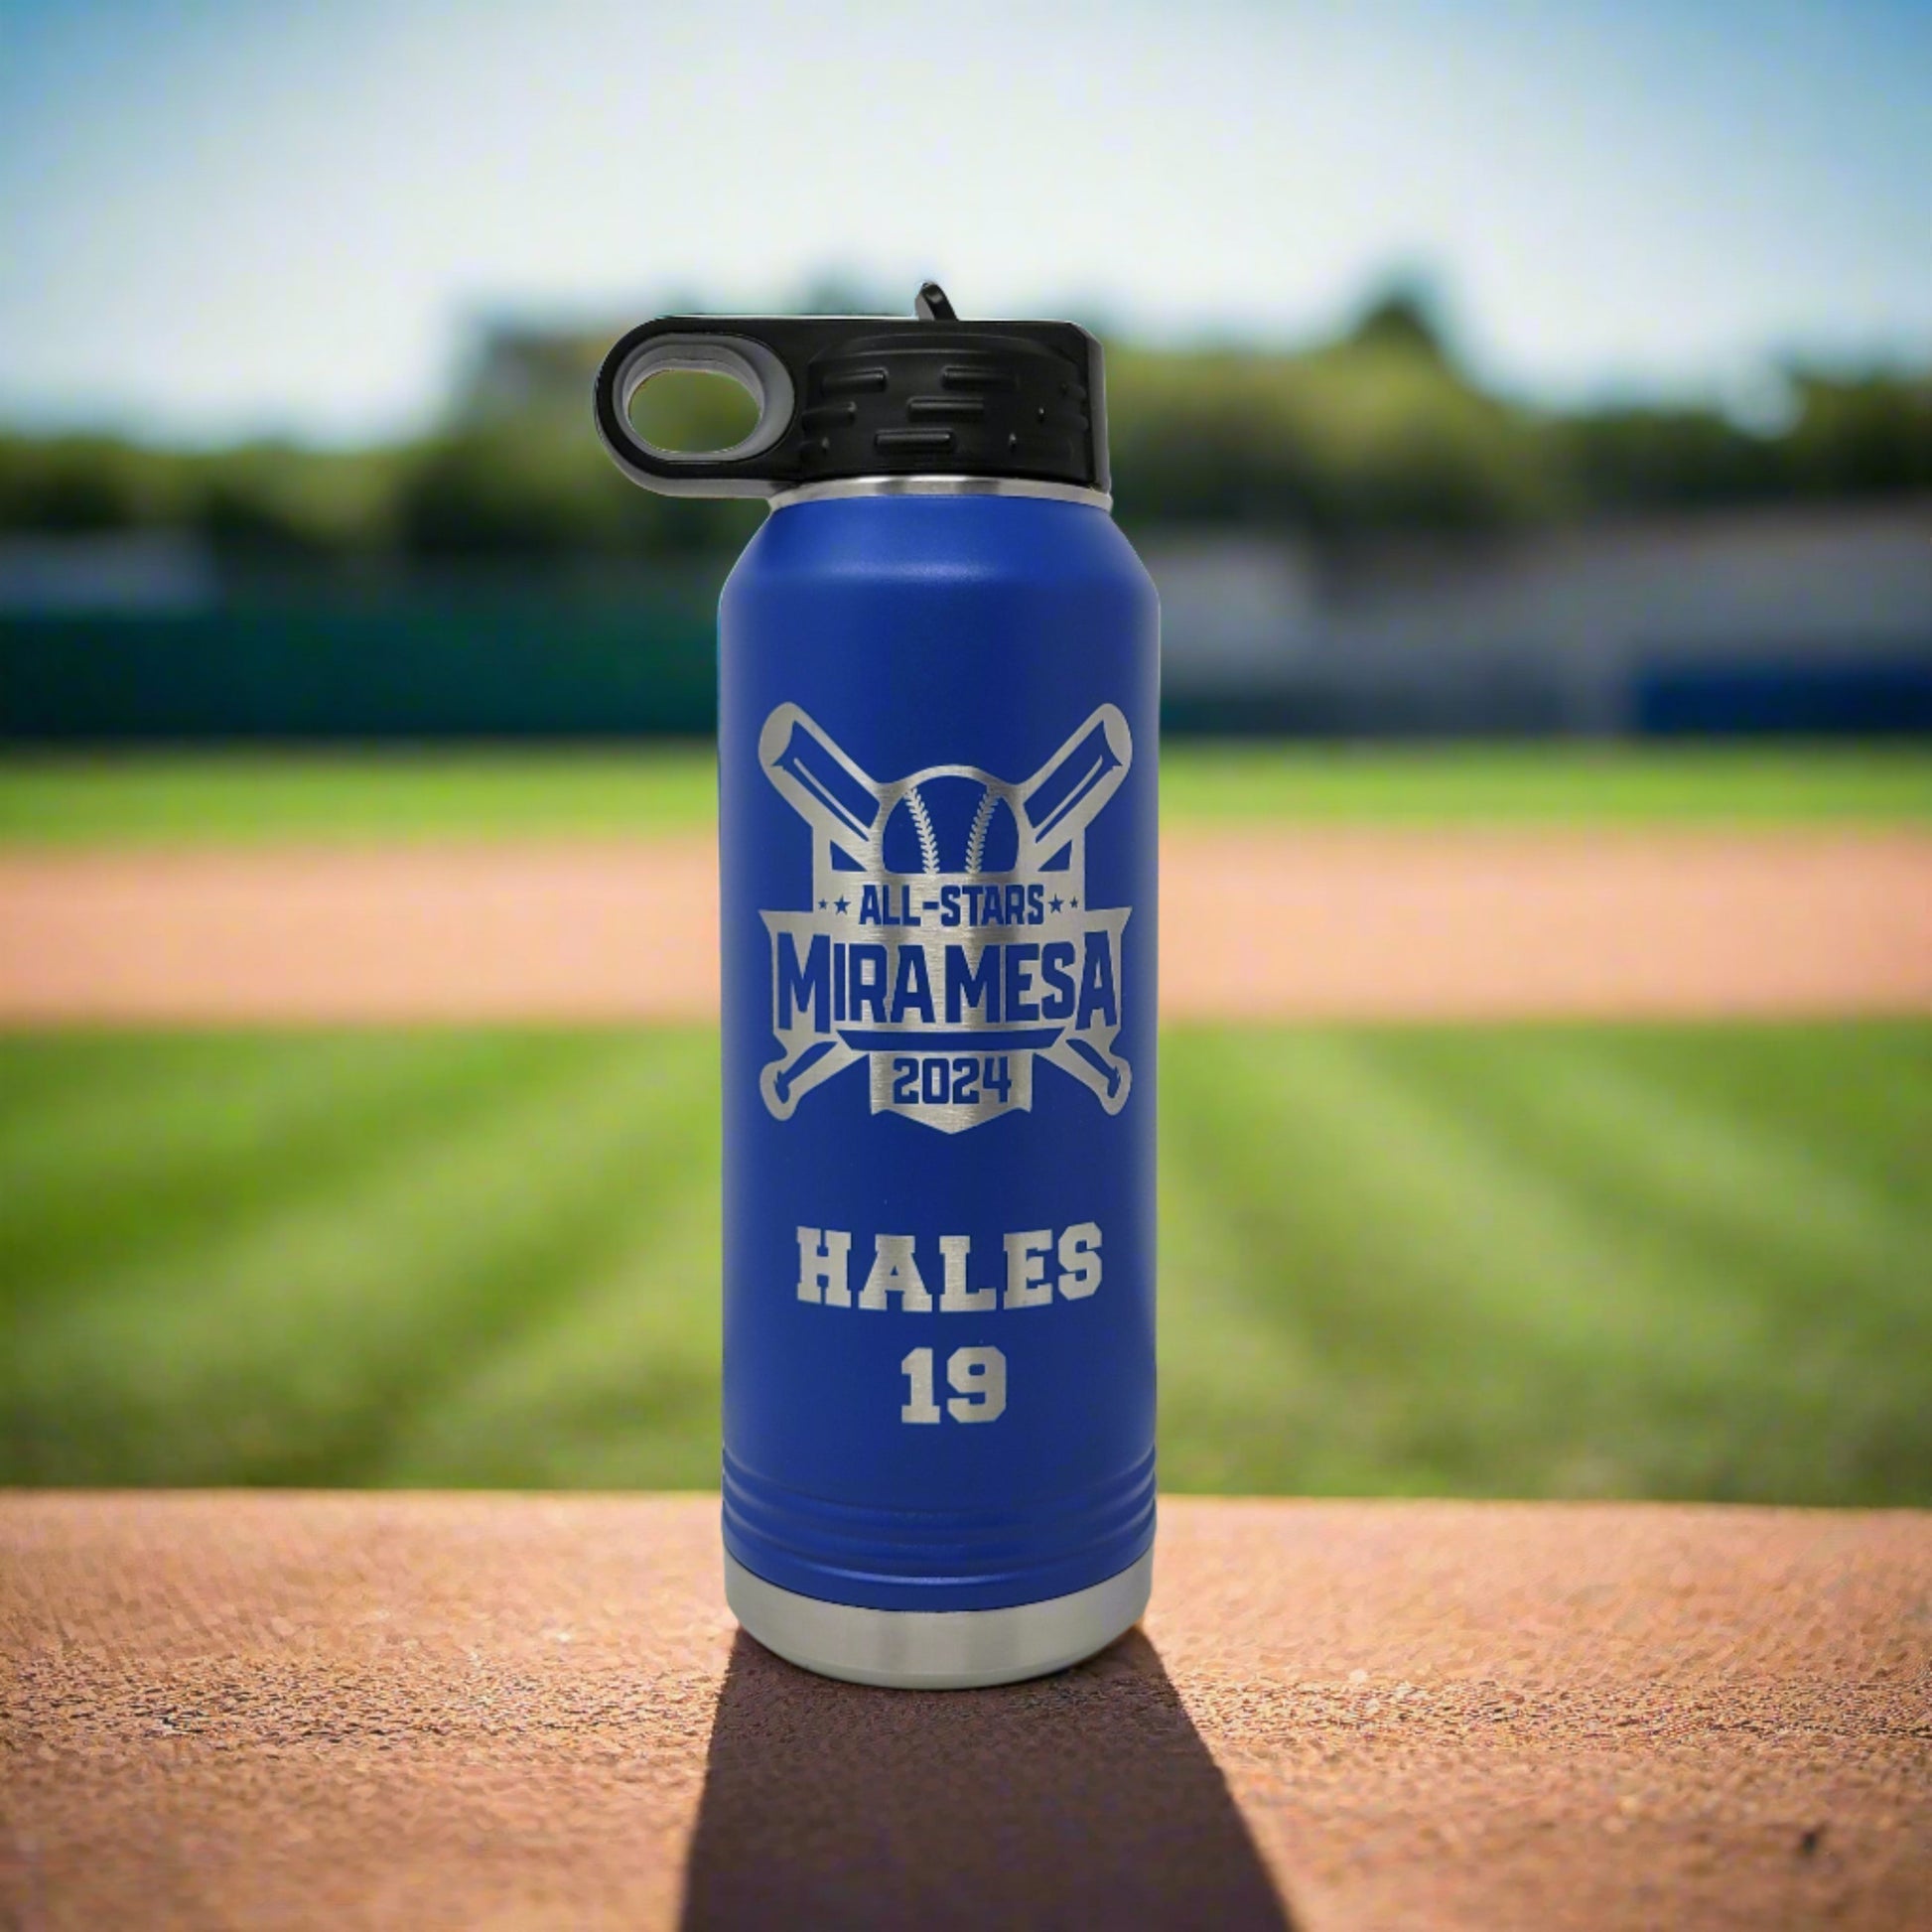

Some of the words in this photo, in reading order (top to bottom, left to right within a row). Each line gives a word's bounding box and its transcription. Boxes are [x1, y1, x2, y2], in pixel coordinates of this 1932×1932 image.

[858, 884, 1044, 927] ALL-STARS
[776, 931, 936, 1034] MIRA
[944, 929, 1118, 1032] MESA
[893, 1055, 1012, 1105] 2024
[796, 1221, 1103, 1312] HALES
[900, 1345, 1007, 1424] 19
